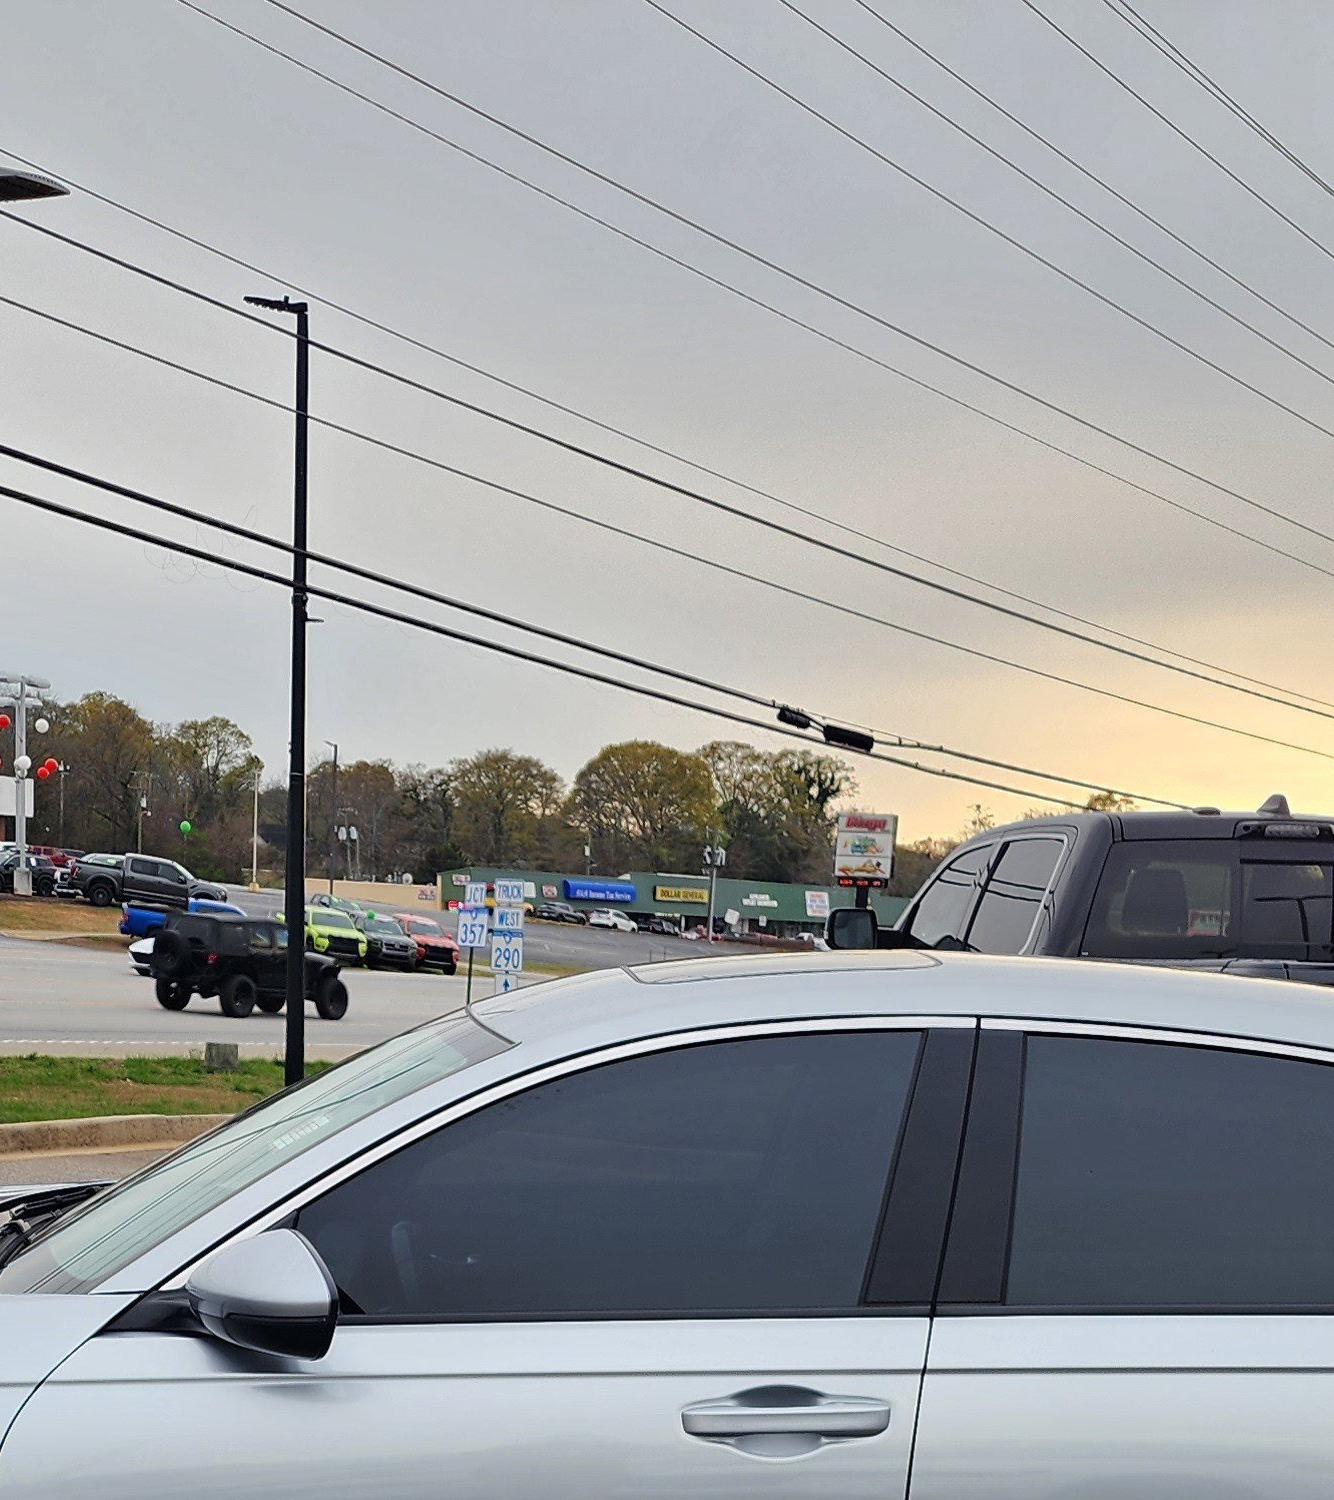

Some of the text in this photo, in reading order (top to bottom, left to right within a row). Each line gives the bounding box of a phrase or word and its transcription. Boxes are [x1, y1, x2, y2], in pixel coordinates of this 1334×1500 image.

[467, 887, 484, 903] JCT
[497, 884, 522, 899] TRUCK
[660, 889, 681, 898] DOLLAR
[498, 912, 520, 927] WEST
[460, 923, 485, 944] 357
[494, 947, 520, 969] 290
